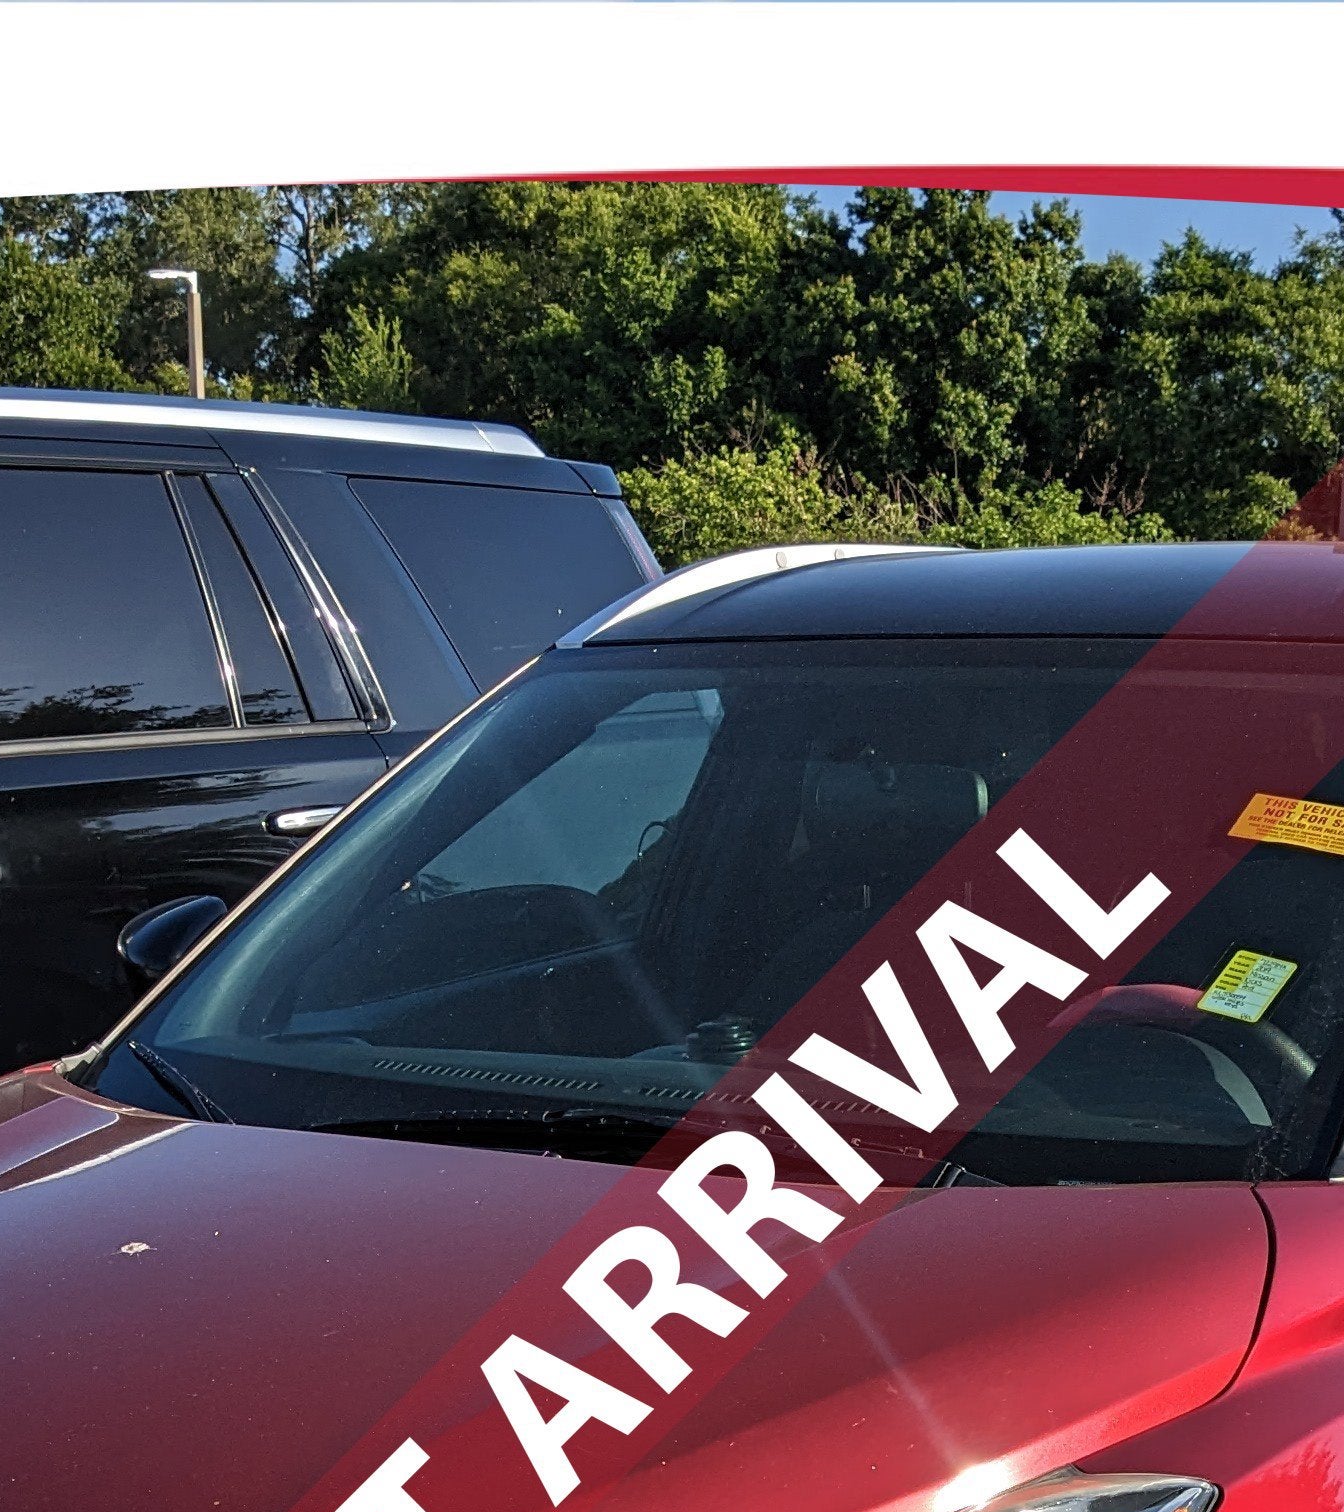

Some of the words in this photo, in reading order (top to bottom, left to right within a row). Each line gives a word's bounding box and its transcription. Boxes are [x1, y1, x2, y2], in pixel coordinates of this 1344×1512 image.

[1264, 797, 1299, 810] THIS
[1263, 808, 1296, 819] NOT
[1297, 813, 1328, 827] FOR
